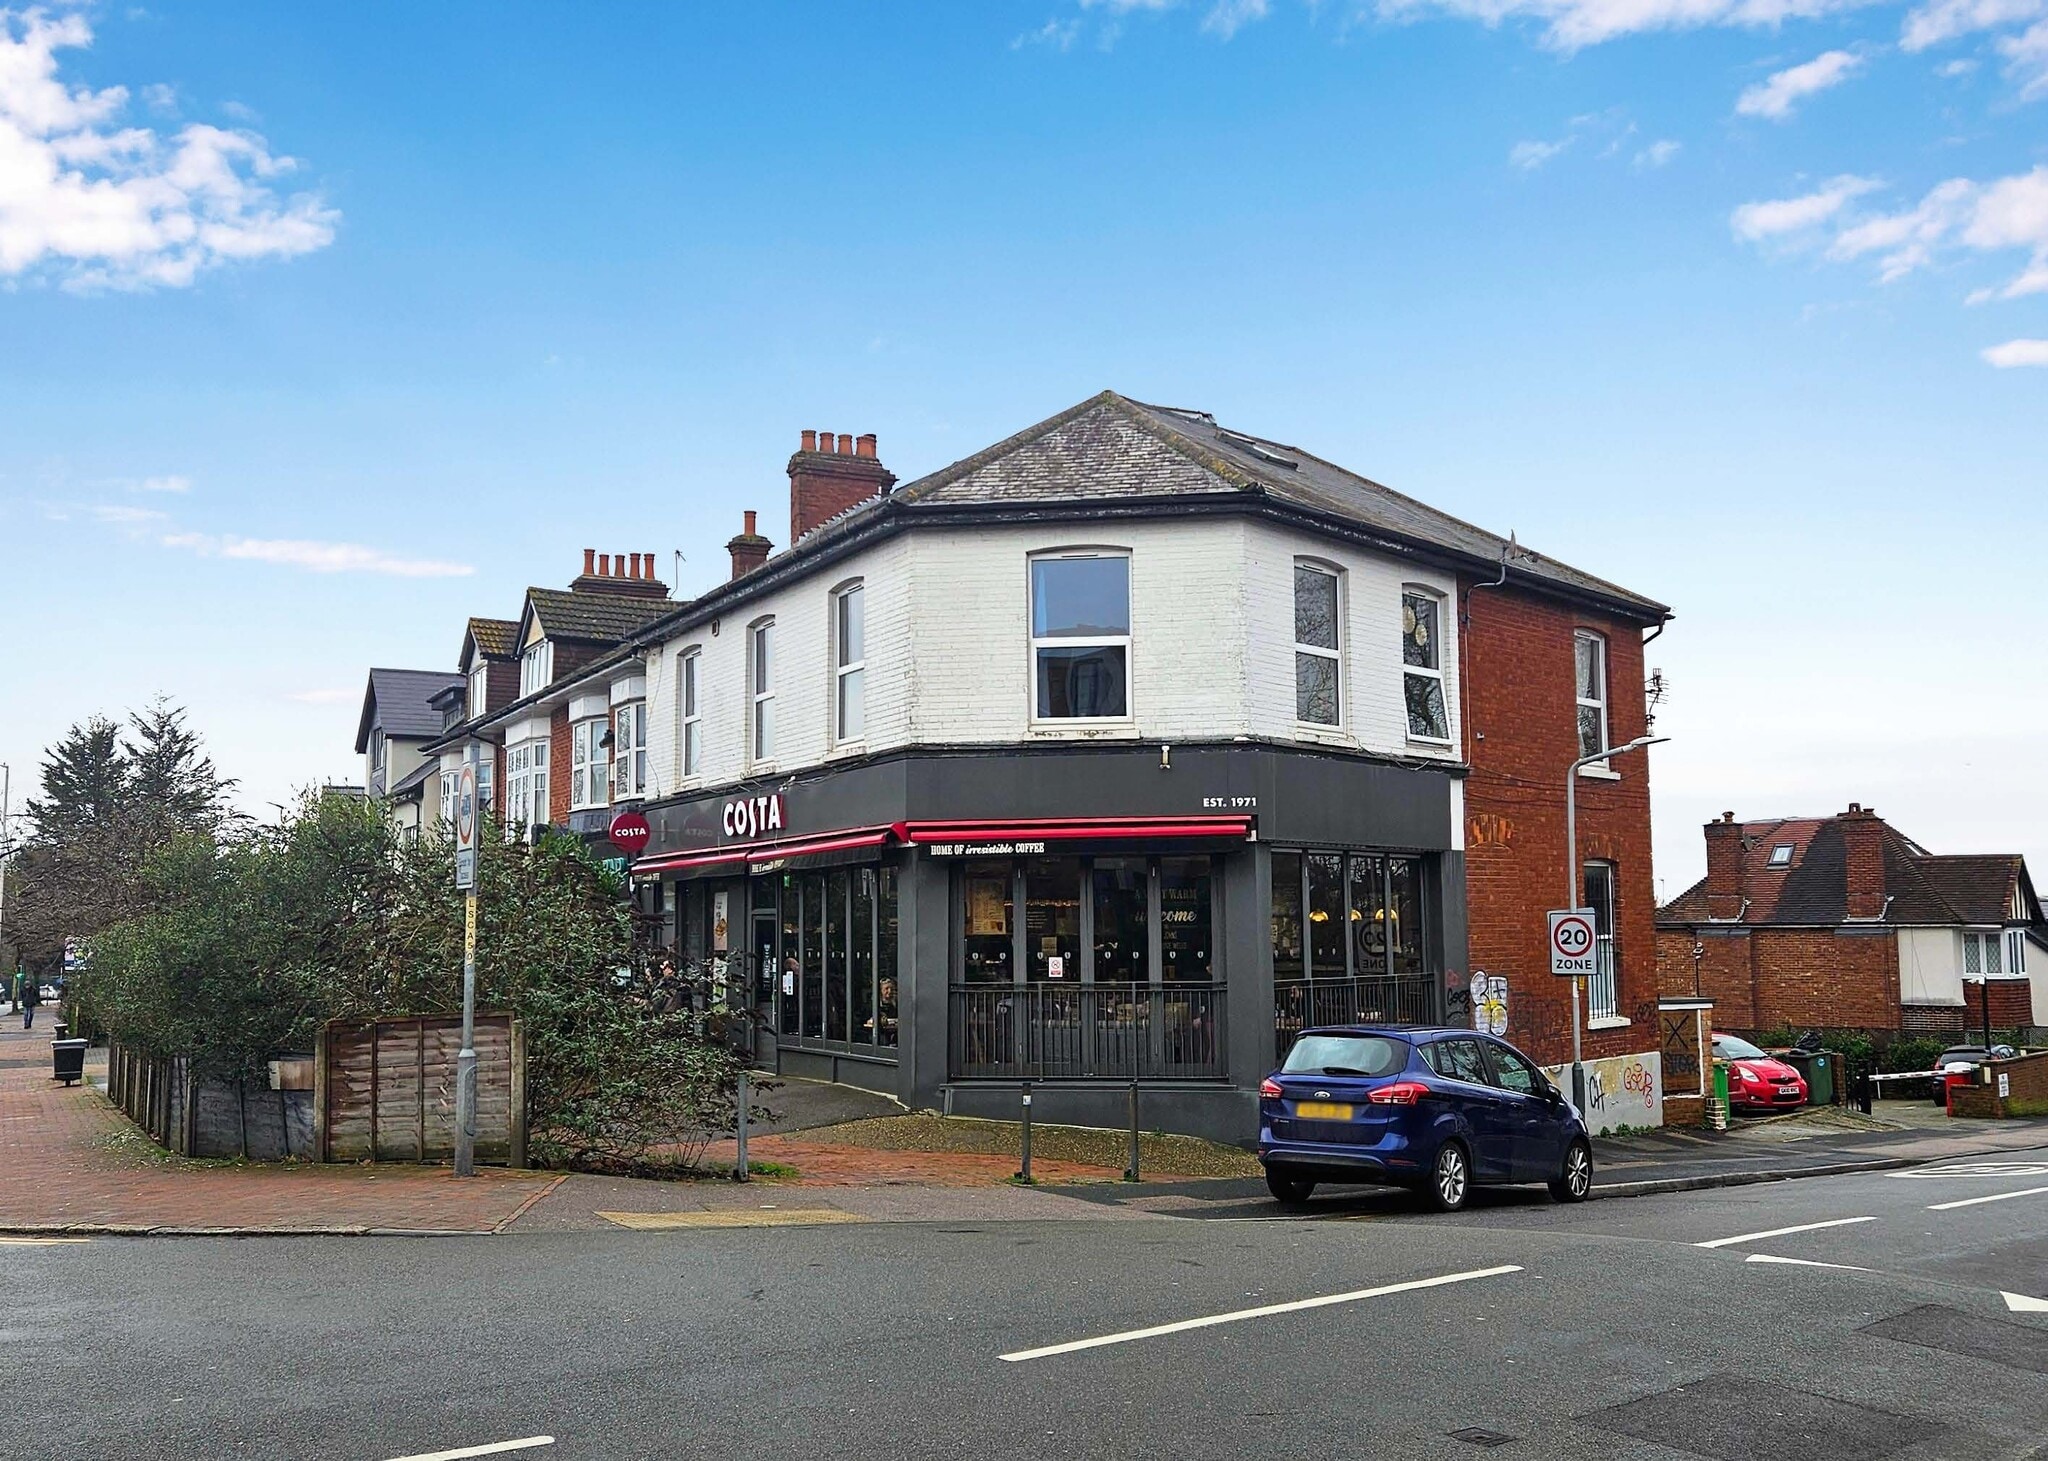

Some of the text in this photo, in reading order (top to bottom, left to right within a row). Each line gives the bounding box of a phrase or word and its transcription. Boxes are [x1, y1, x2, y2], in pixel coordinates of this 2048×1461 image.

[1203, 797, 1257, 807] EST. 1971
[723, 794, 781, 837] COSTA
[614, 827, 647, 837] COSTA
[930, 842, 1045, 855] HOME OF irresistible COFFEE
[1560, 929, 1587, 945] 20
[1556, 959, 1592, 970] ZONE
